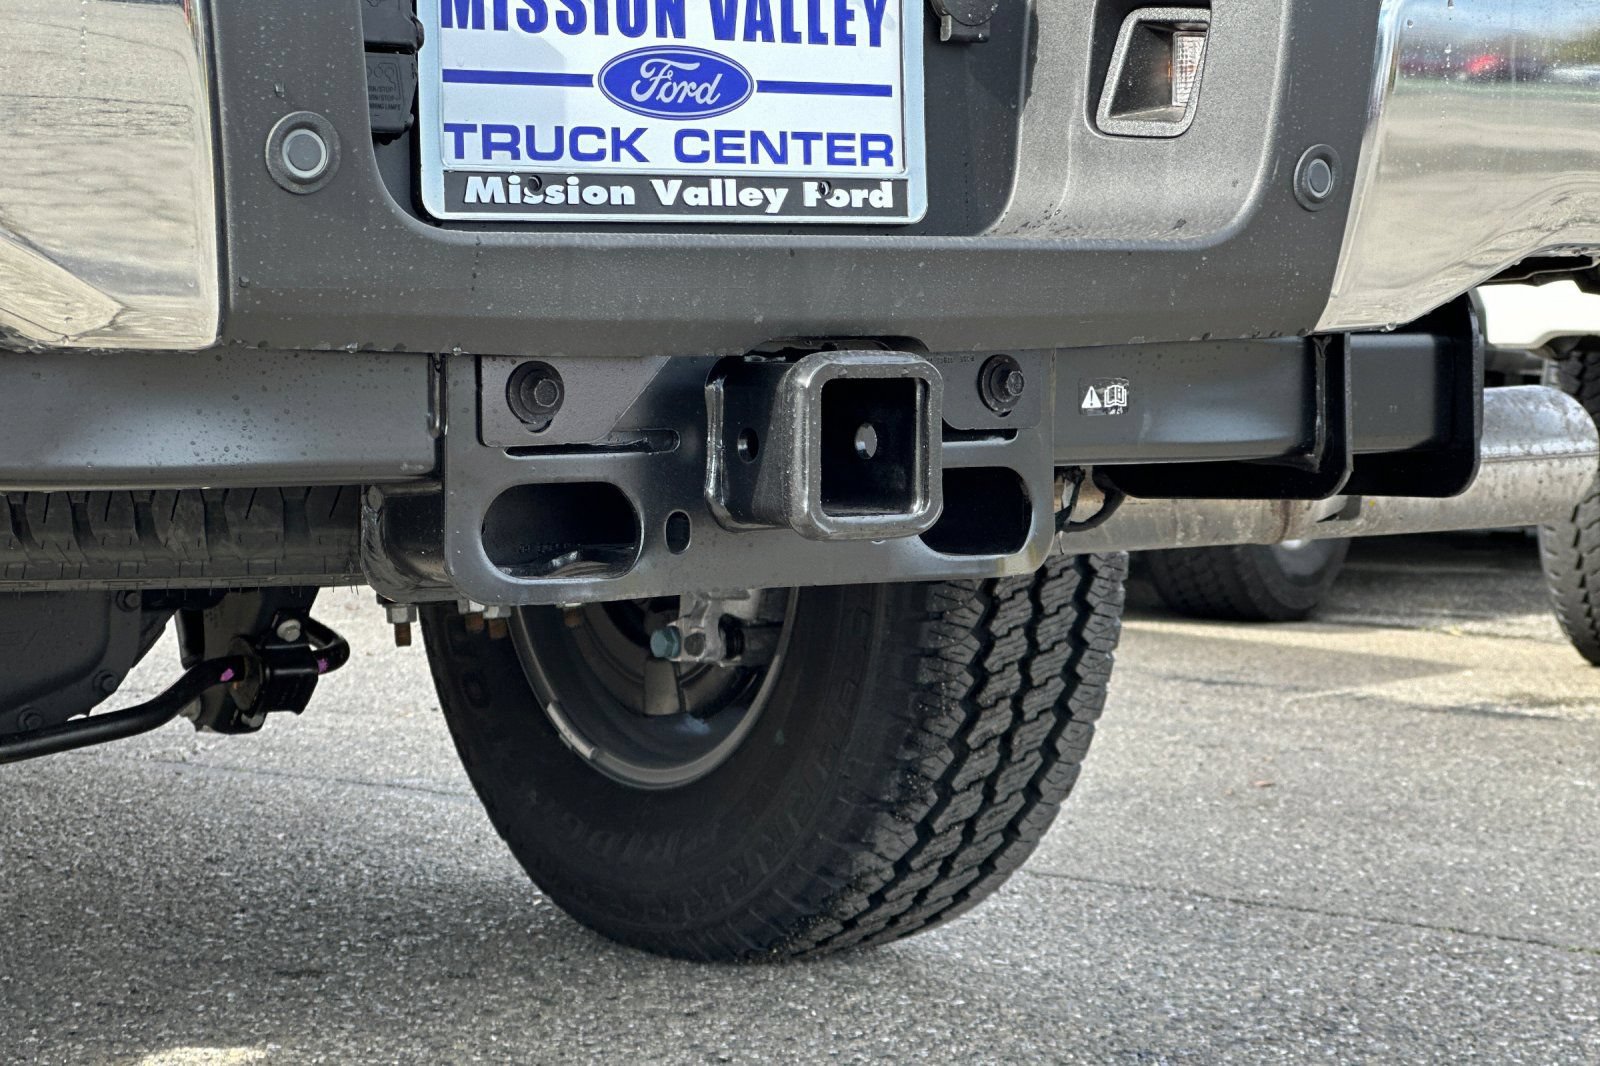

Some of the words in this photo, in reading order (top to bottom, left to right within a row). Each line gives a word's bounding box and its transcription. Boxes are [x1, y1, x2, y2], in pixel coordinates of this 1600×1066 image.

[441, 0, 687, 39] MISSION
[711, 0, 887, 48] VALLEY
[630, 58, 723, 105] Ford
[443, 123, 649, 163] TRUCK
[674, 129, 895, 168] CENTER
[651, 178, 789, 214] Valley
[802, 181, 894, 209] Ford
